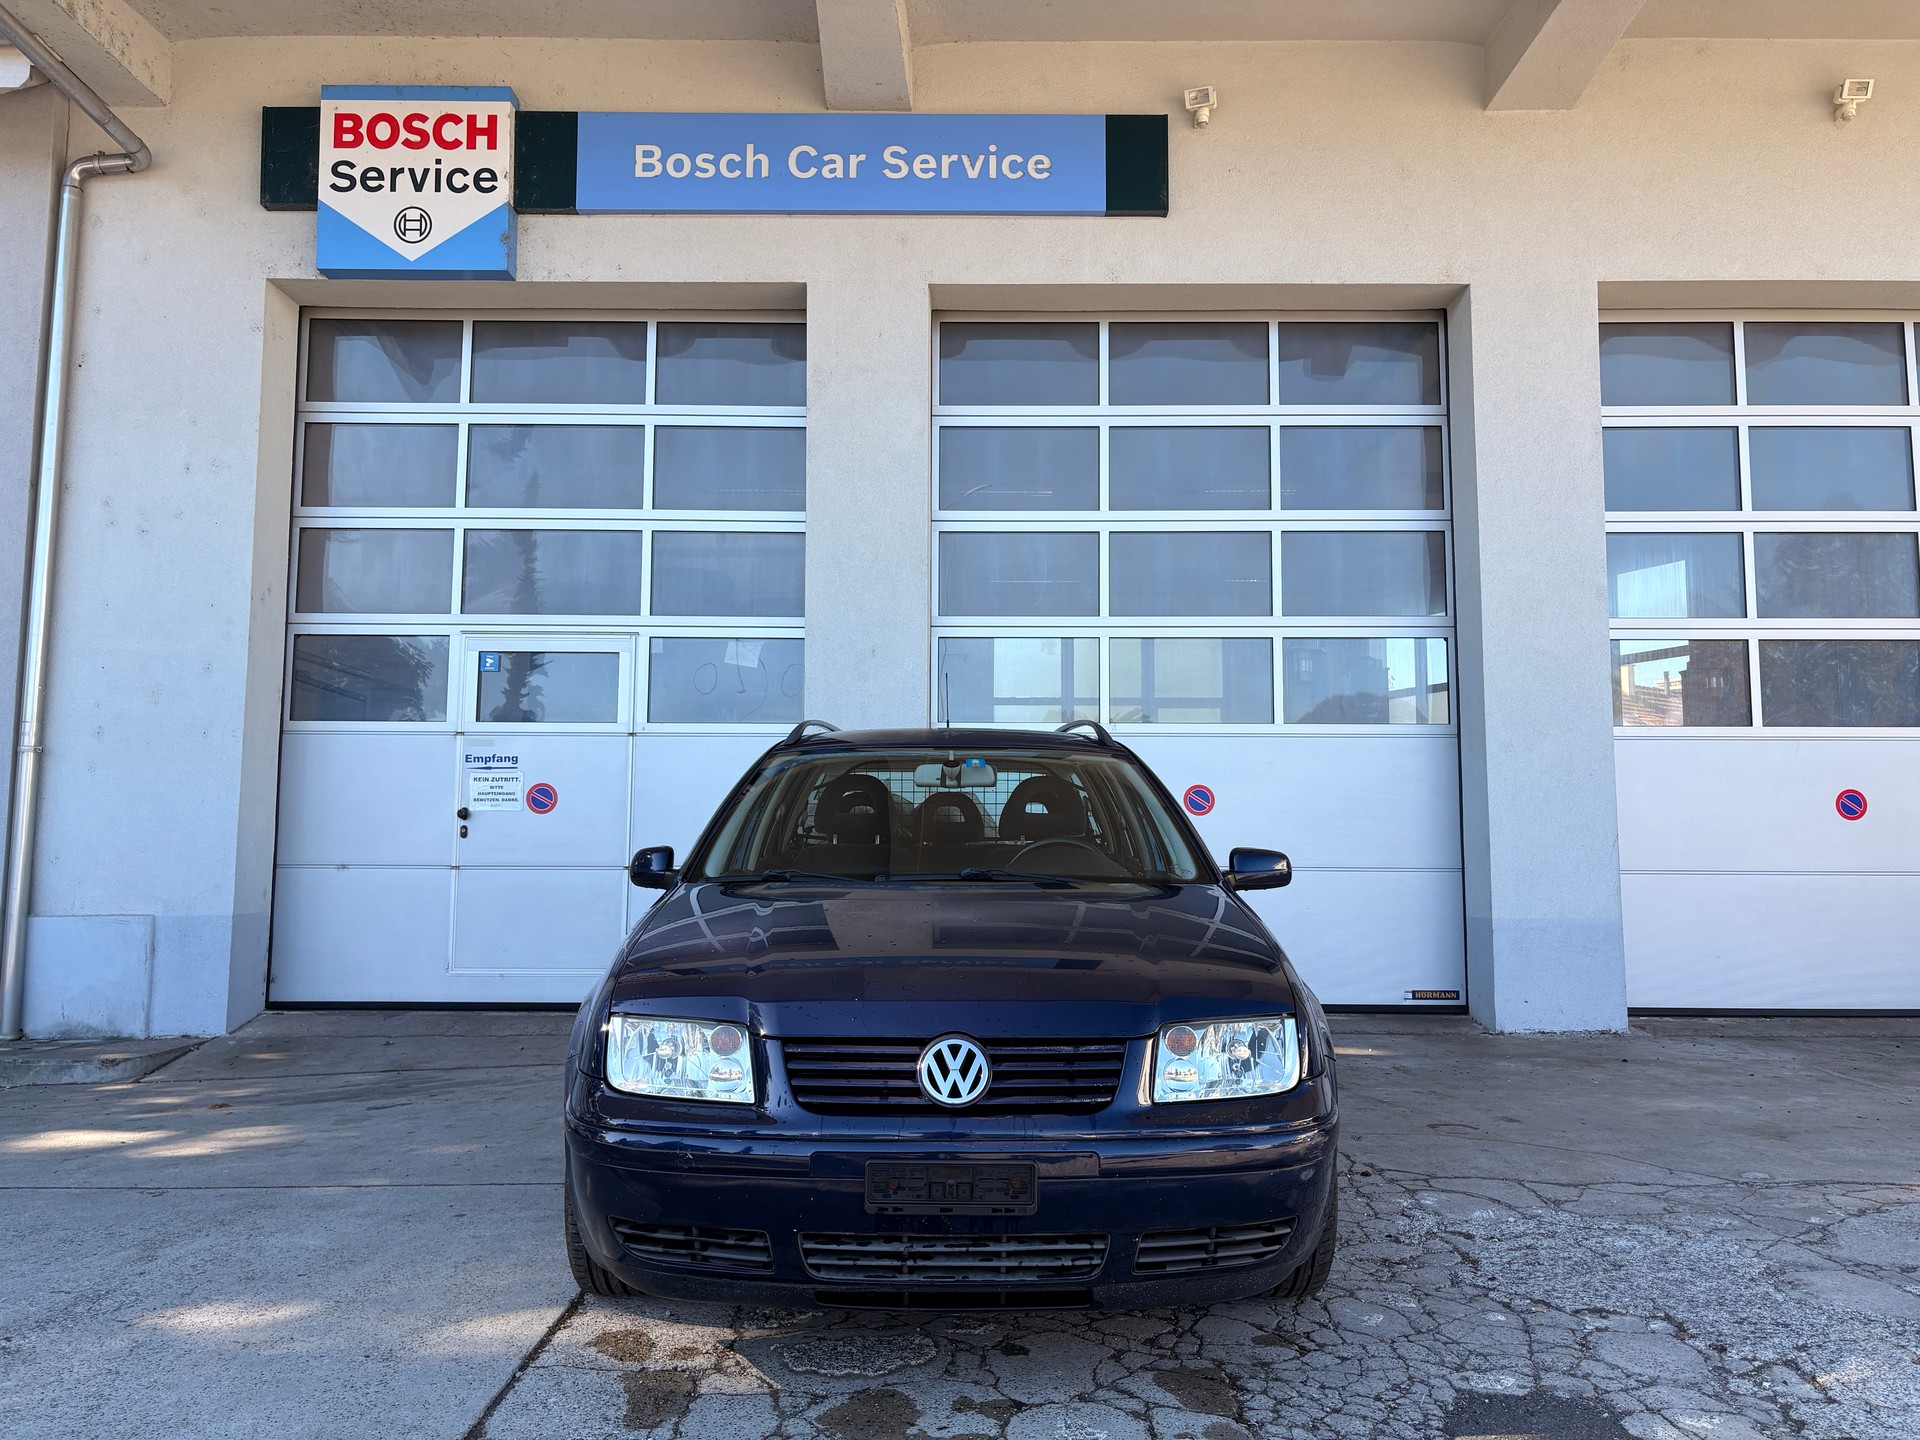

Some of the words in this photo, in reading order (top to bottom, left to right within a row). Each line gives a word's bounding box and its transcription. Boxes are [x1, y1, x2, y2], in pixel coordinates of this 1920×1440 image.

[333, 112, 498, 150] BOSCH
[329, 158, 499, 194] Service
[634, 143, 770, 179] Bosch
[787, 145, 866, 180] Car
[882, 145, 1052, 180] Service
[465, 754, 518, 765] Empfang
